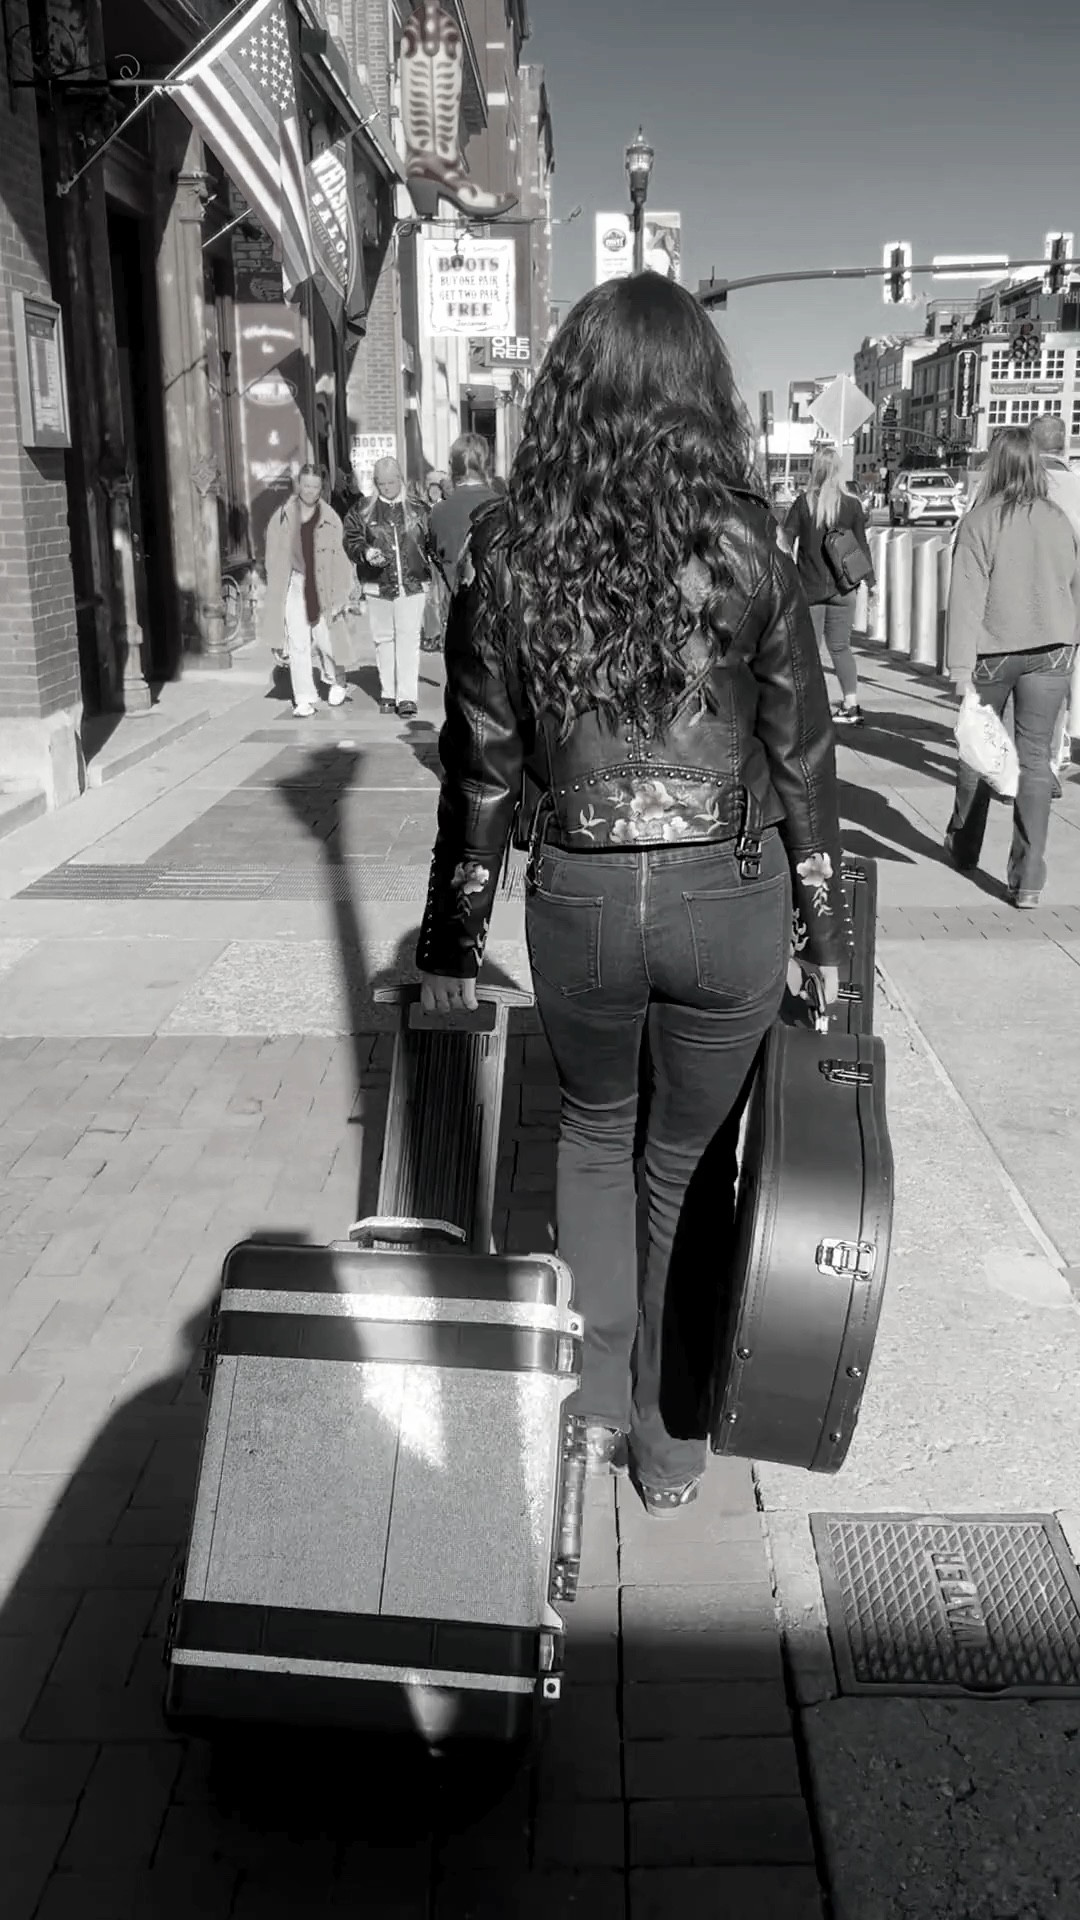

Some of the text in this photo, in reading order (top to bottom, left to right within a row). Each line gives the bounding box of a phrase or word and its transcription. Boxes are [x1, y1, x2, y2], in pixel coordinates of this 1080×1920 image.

[312, 192, 348, 286] SALO
[438, 256, 499, 272] BOOTS
[441, 275, 499, 288] BUY ONE PAIR
[440, 289, 500, 301] GET TWO PAIR
[447, 302, 493, 317] FREE
[491, 336, 530, 349] OLE
[491, 347, 530, 360] RED
[353, 436, 393, 448] BOOTS
[932, 1552, 987, 1647] WATER
